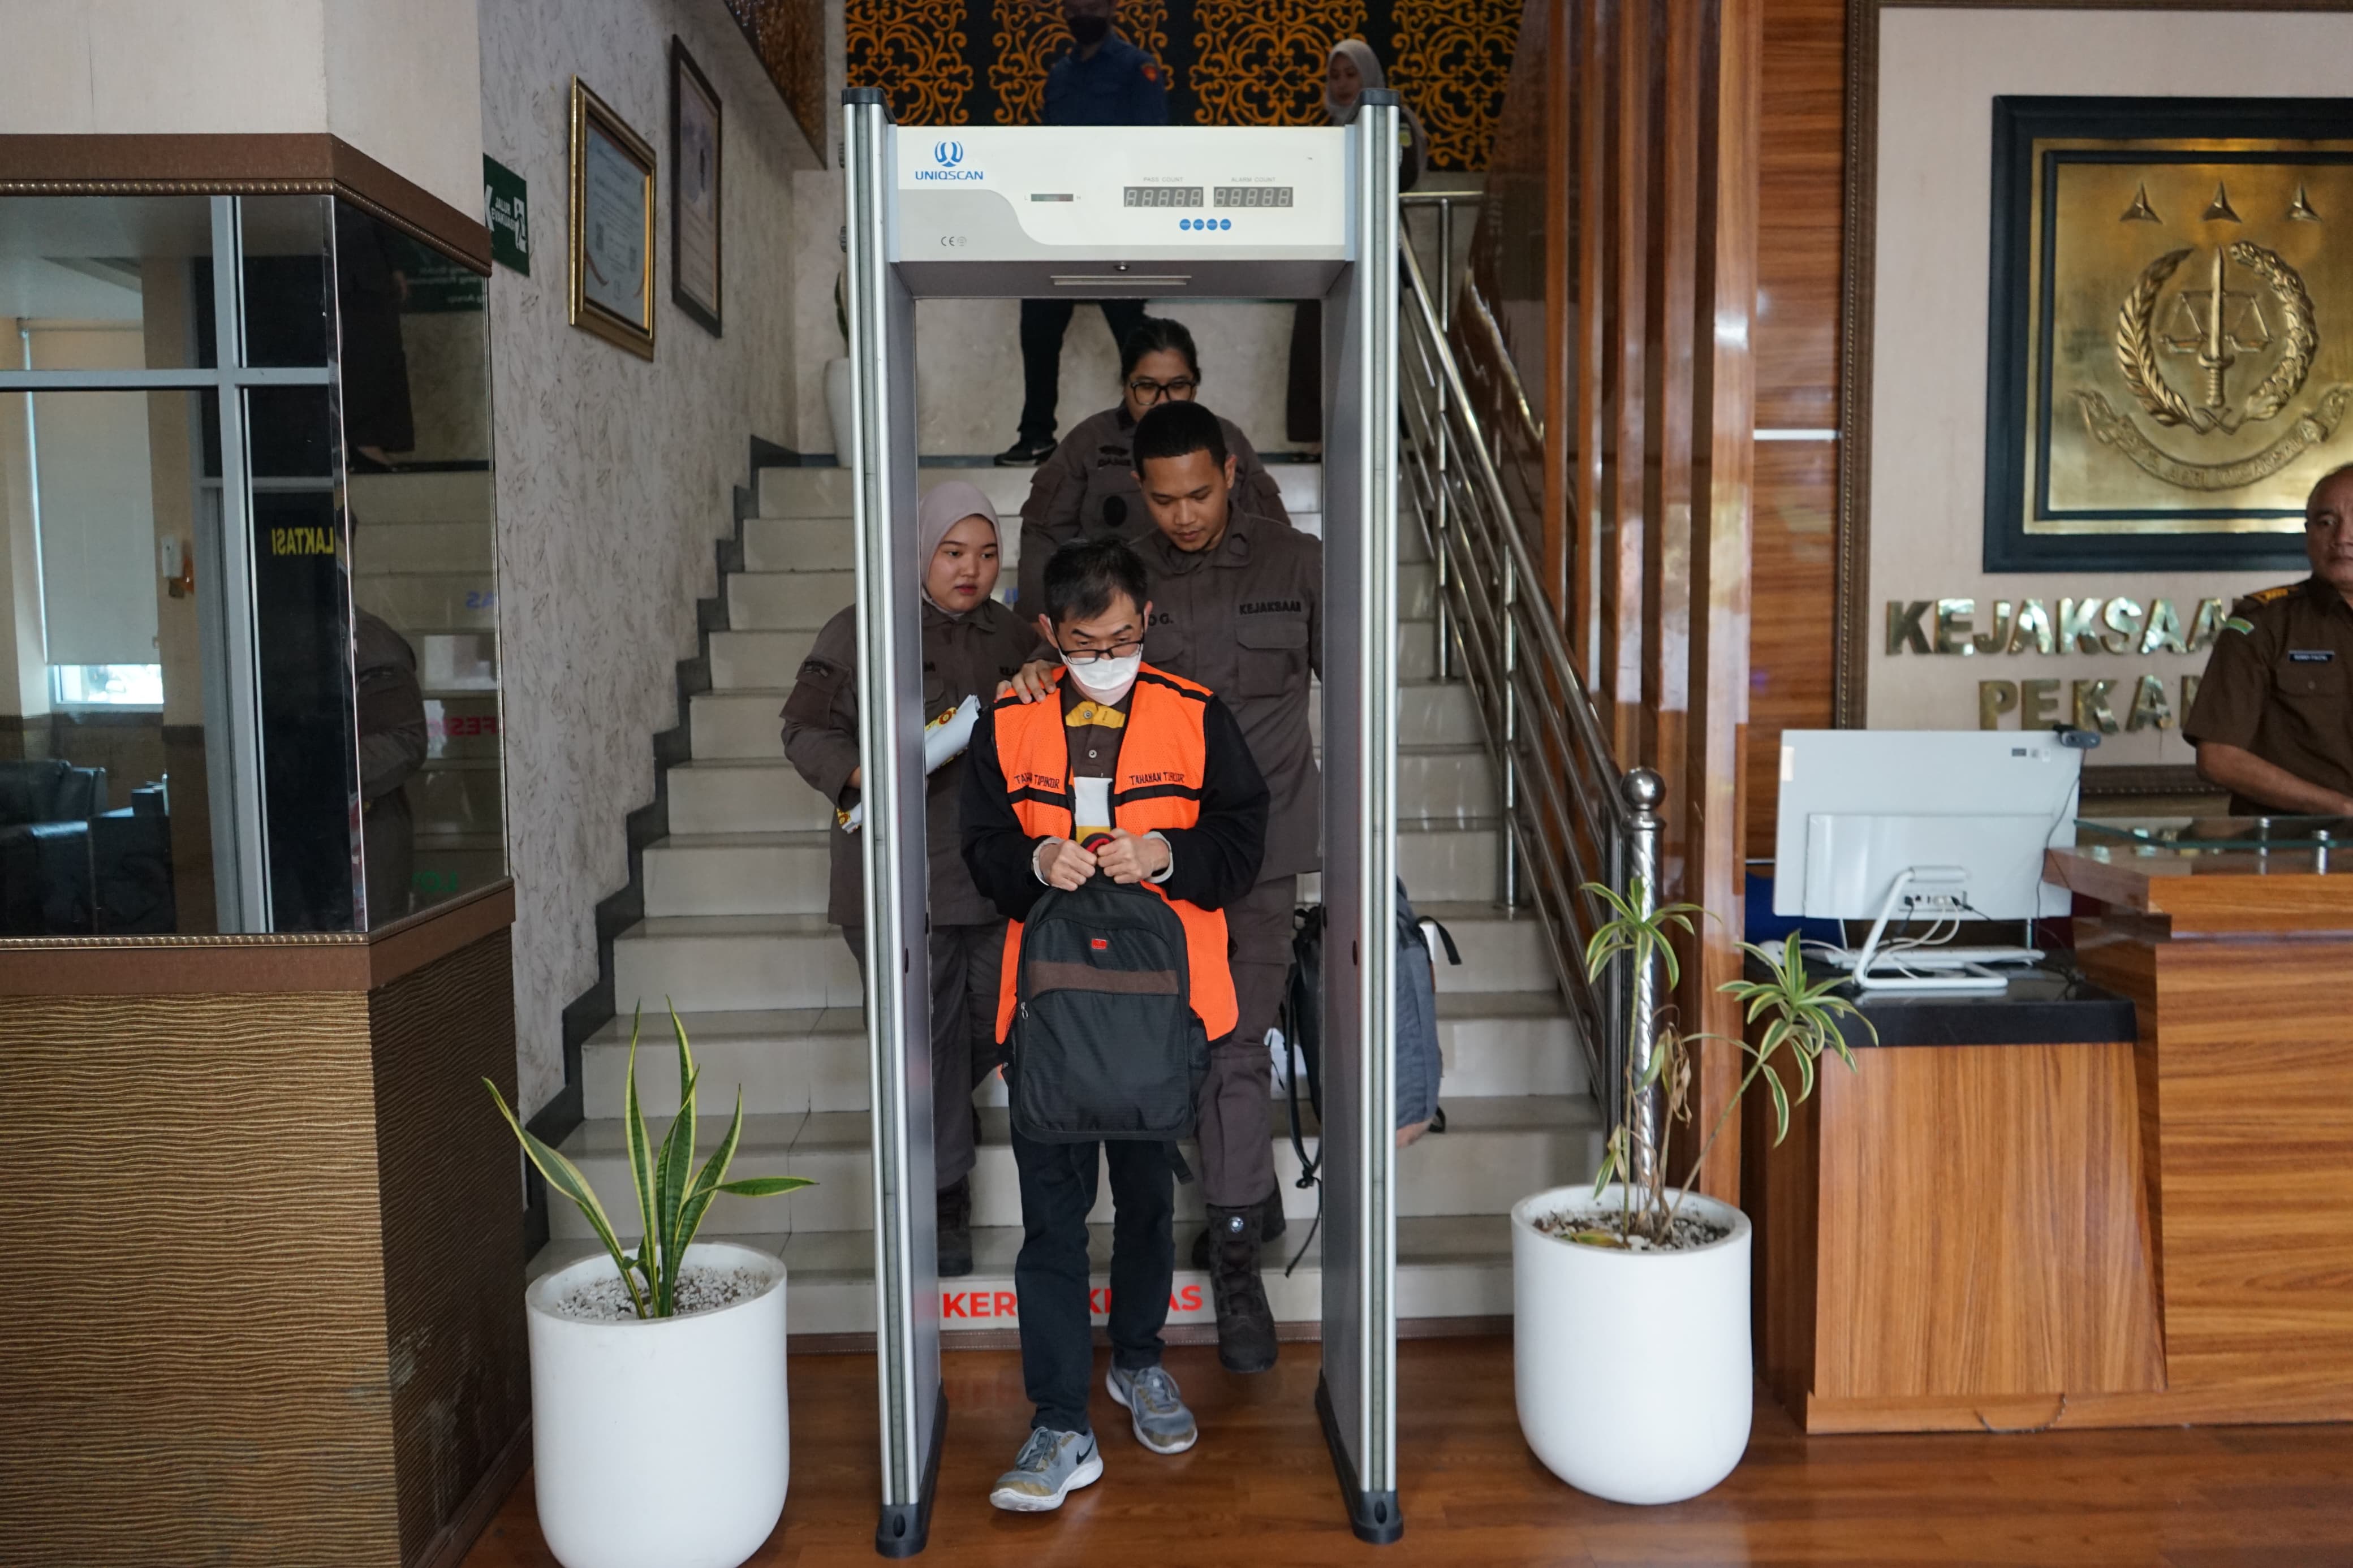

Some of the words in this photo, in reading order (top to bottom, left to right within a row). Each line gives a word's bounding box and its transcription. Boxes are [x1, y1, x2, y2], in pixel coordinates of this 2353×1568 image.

[915, 171, 984, 180] UNIQSCAN
[1885, 597, 2244, 657] KEJAKSAA
[1128, 772, 1162, 785] TAHANAN
